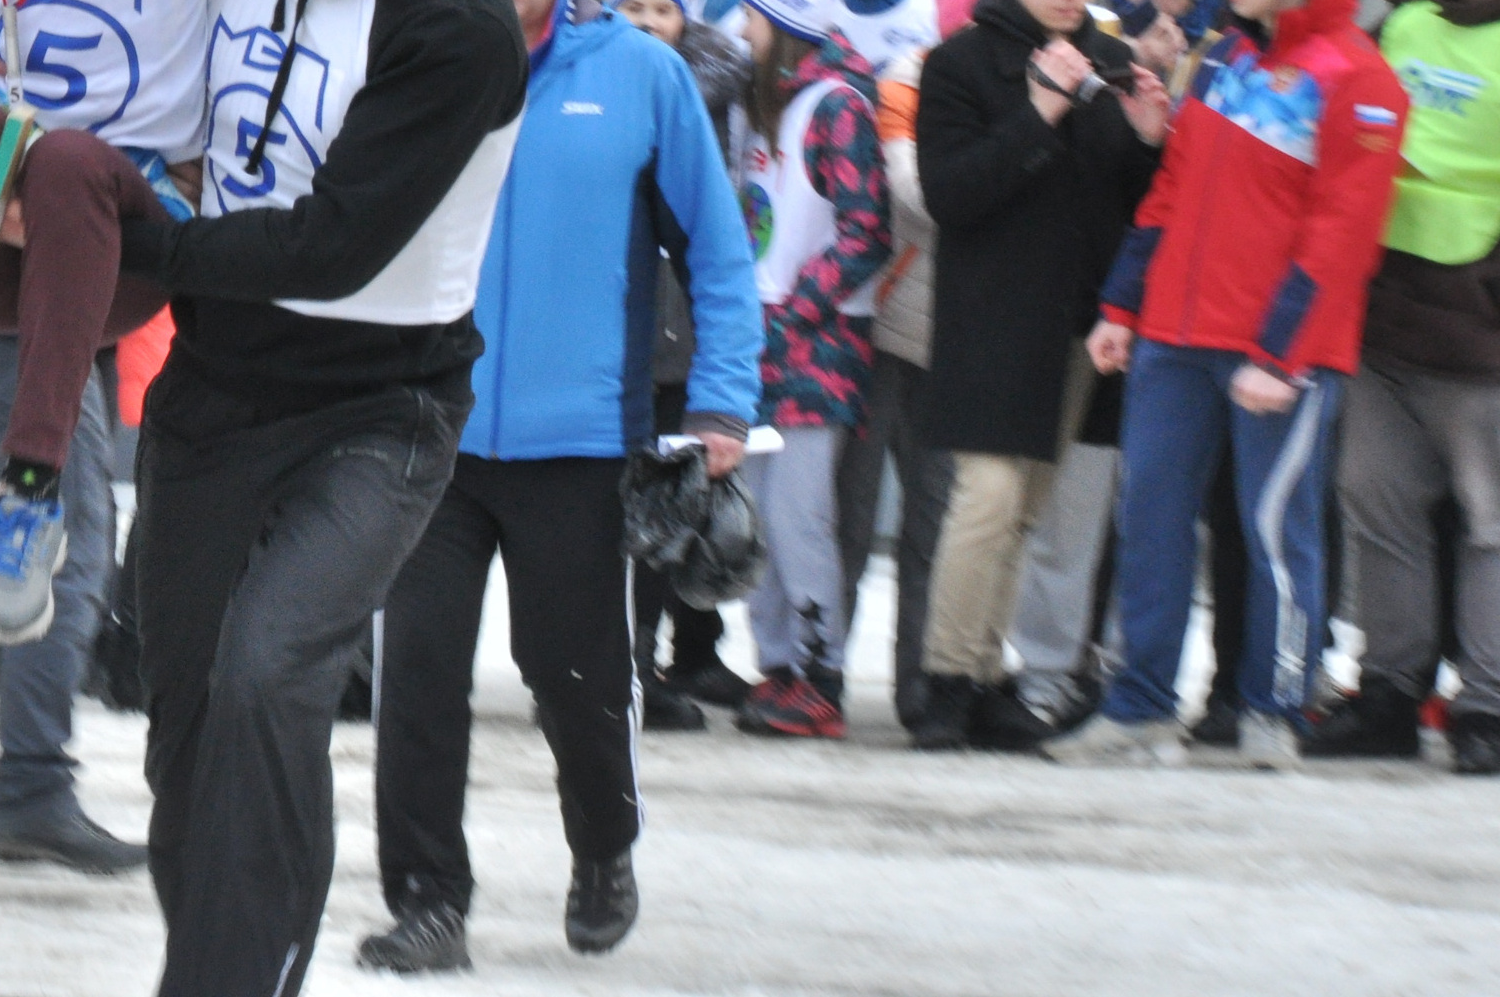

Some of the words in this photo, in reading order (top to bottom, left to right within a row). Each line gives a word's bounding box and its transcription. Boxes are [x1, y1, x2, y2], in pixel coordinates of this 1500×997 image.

[10, 87, 20, 104] 5
[22, 30, 103, 111] 5
[221, 116, 287, 198] 5
